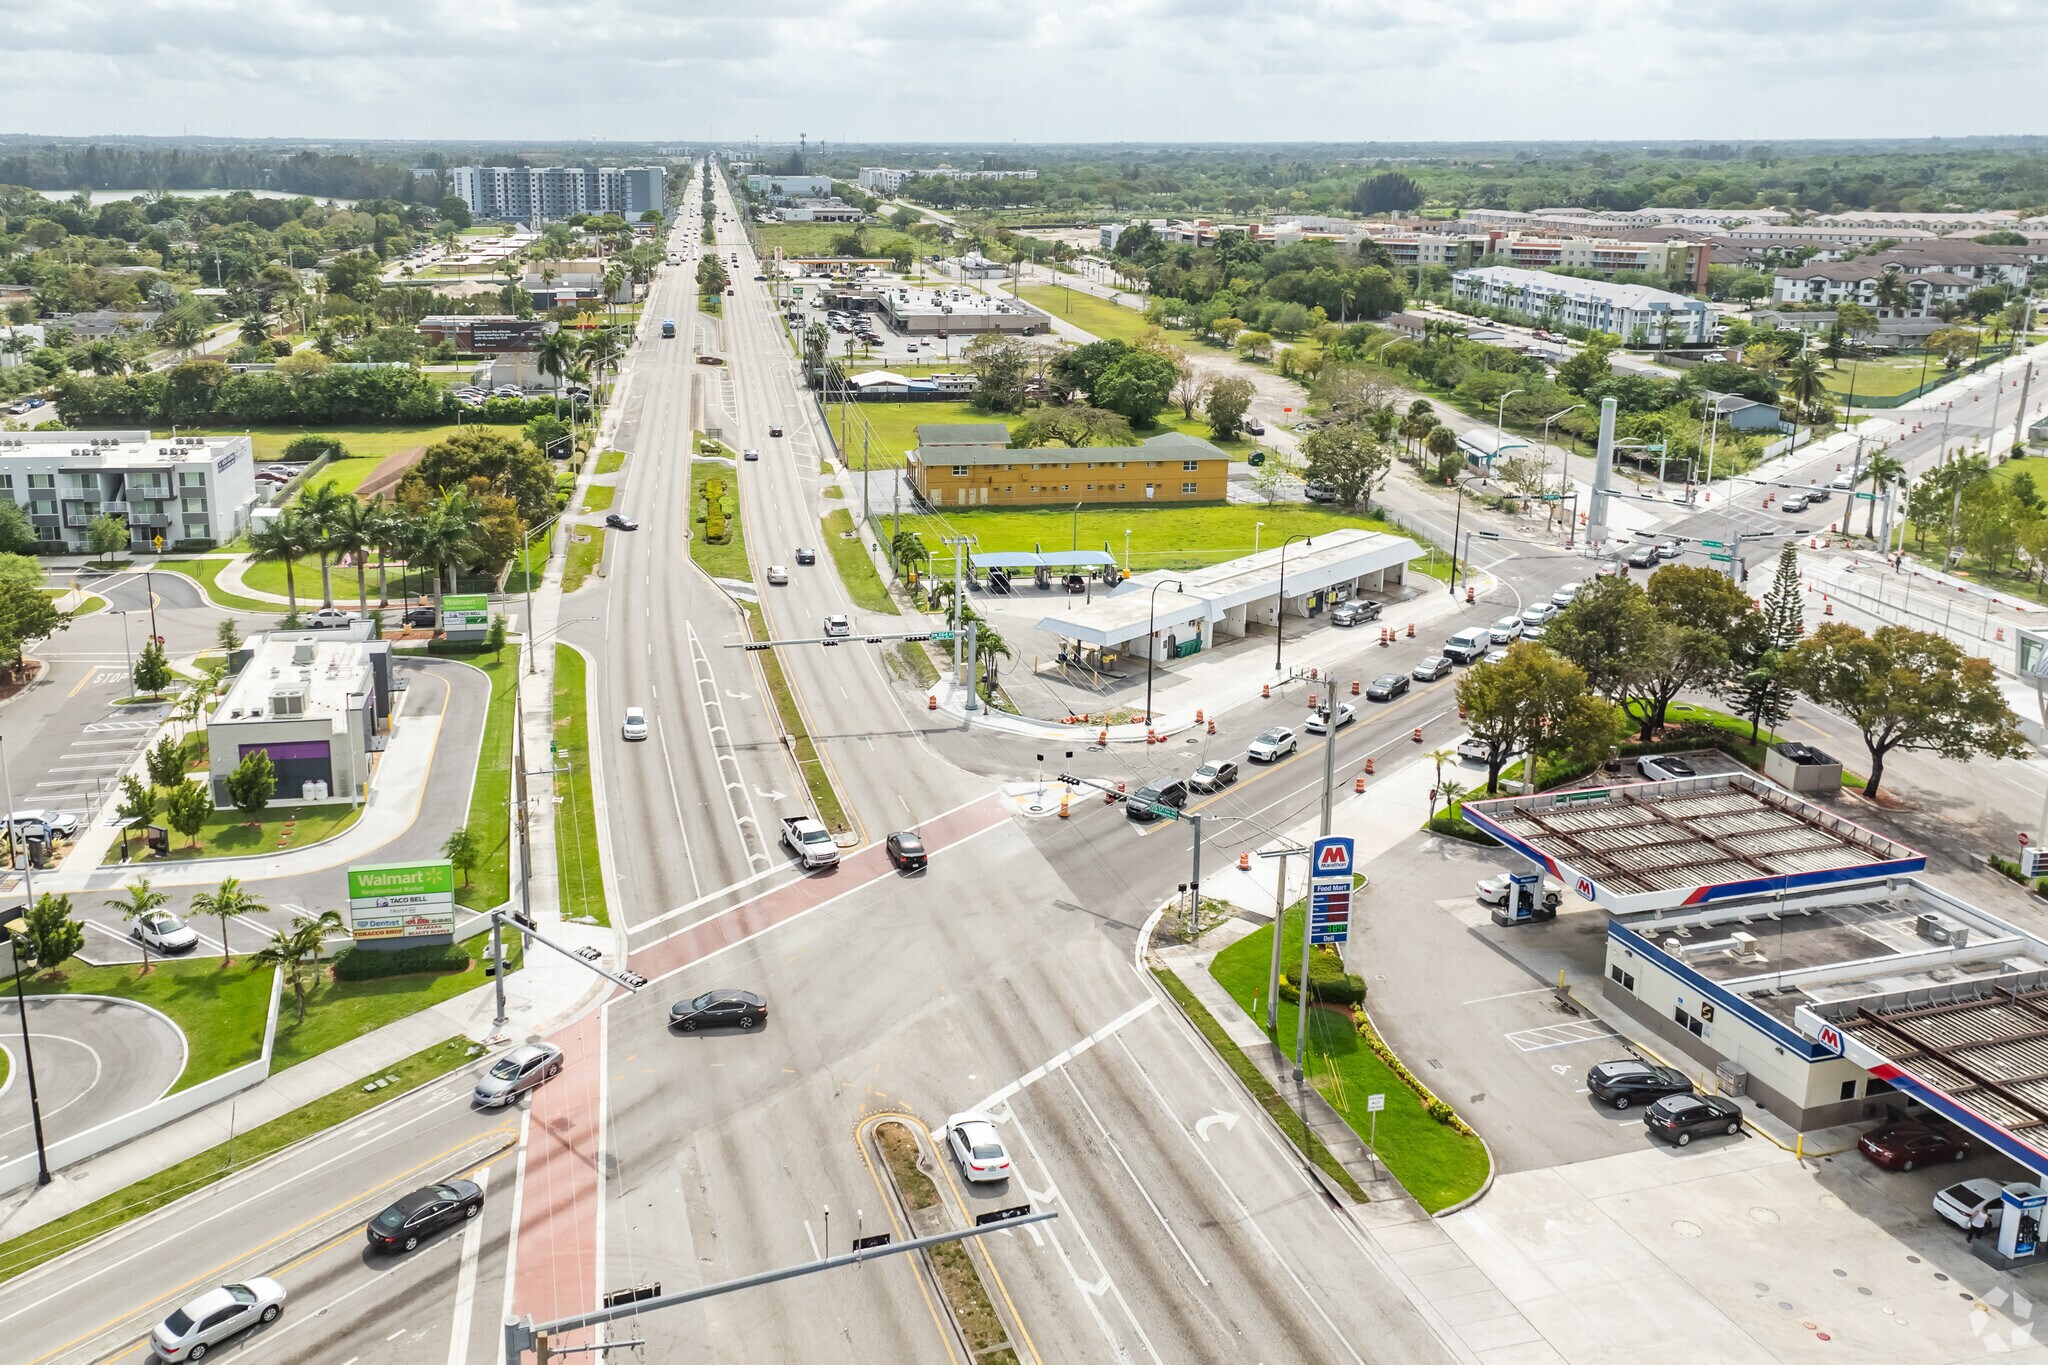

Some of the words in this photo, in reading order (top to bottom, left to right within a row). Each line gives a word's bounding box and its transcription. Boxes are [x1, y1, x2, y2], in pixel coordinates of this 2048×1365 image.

[93, 673, 130, 684] STOP
[358, 871, 424, 887] Walmart
[370, 920, 400, 928] Dentist
